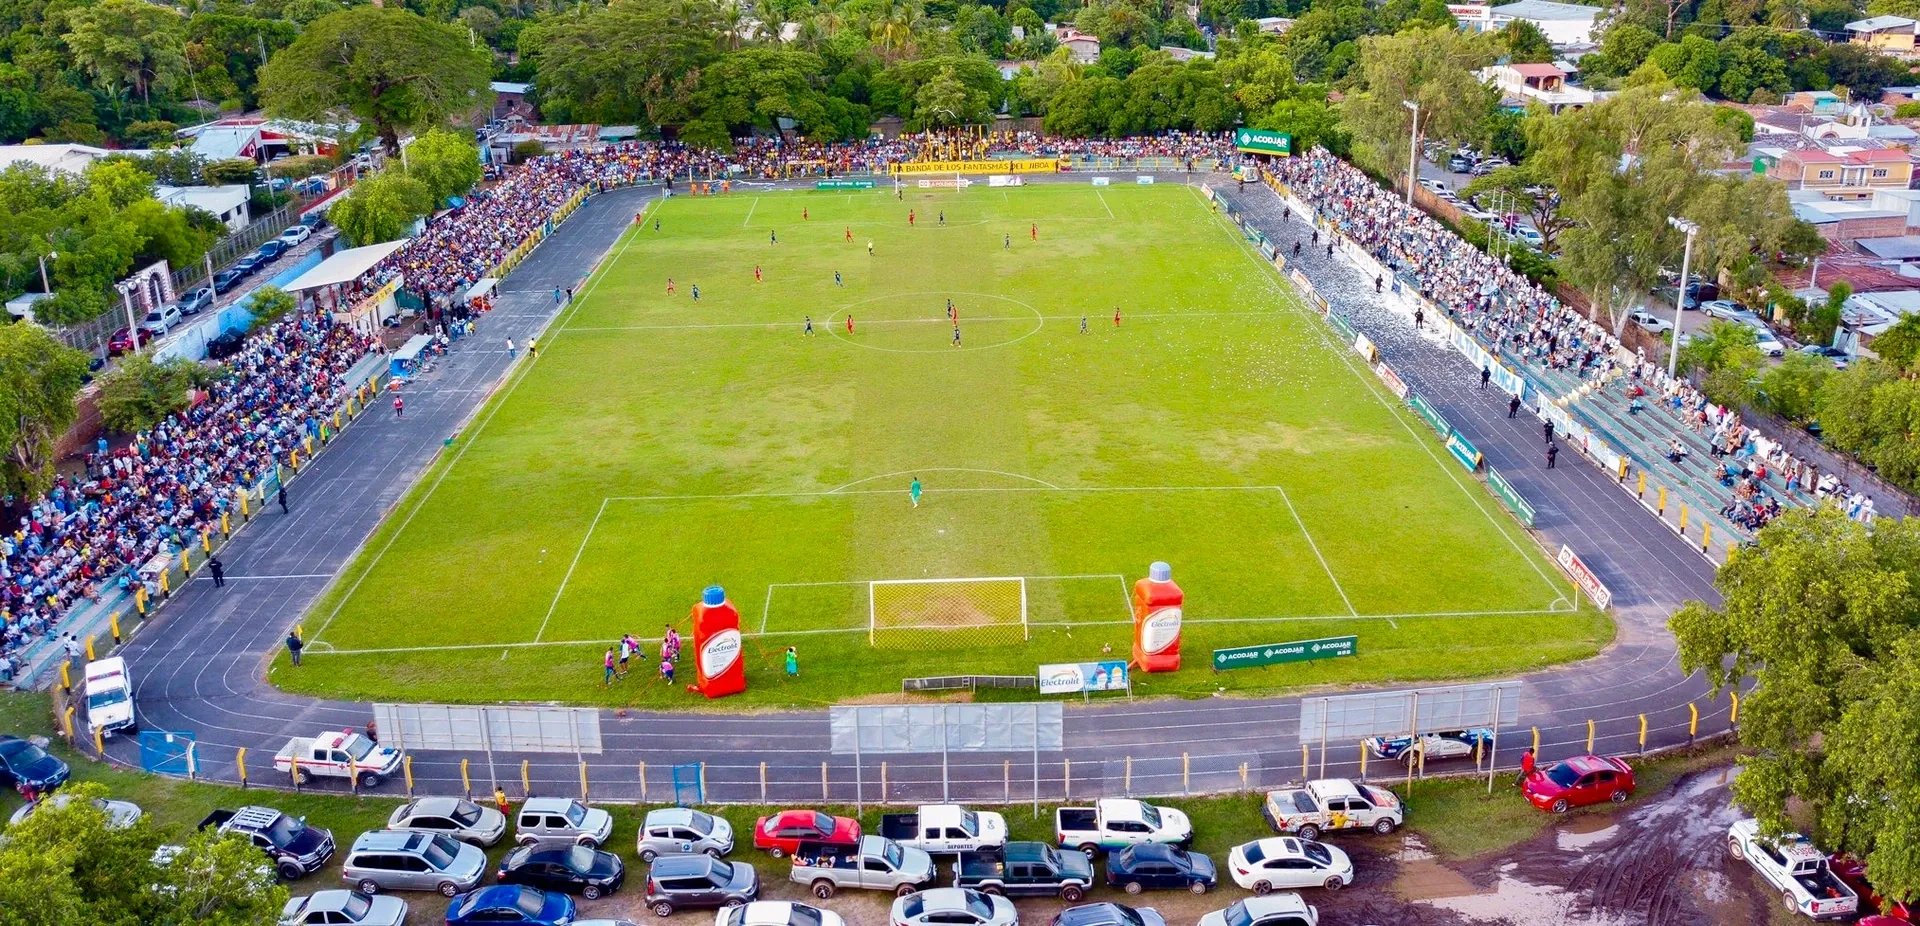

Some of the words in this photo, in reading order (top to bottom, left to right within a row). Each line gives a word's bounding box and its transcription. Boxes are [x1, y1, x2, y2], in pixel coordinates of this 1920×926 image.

[1252, 135, 1288, 145] ACODJAR
[906, 164, 932, 172] BANDA
[947, 163, 961, 171] LOS
[1321, 641, 1351, 649] ACODJAR
[1274, 647, 1304, 655] ACODJAR
